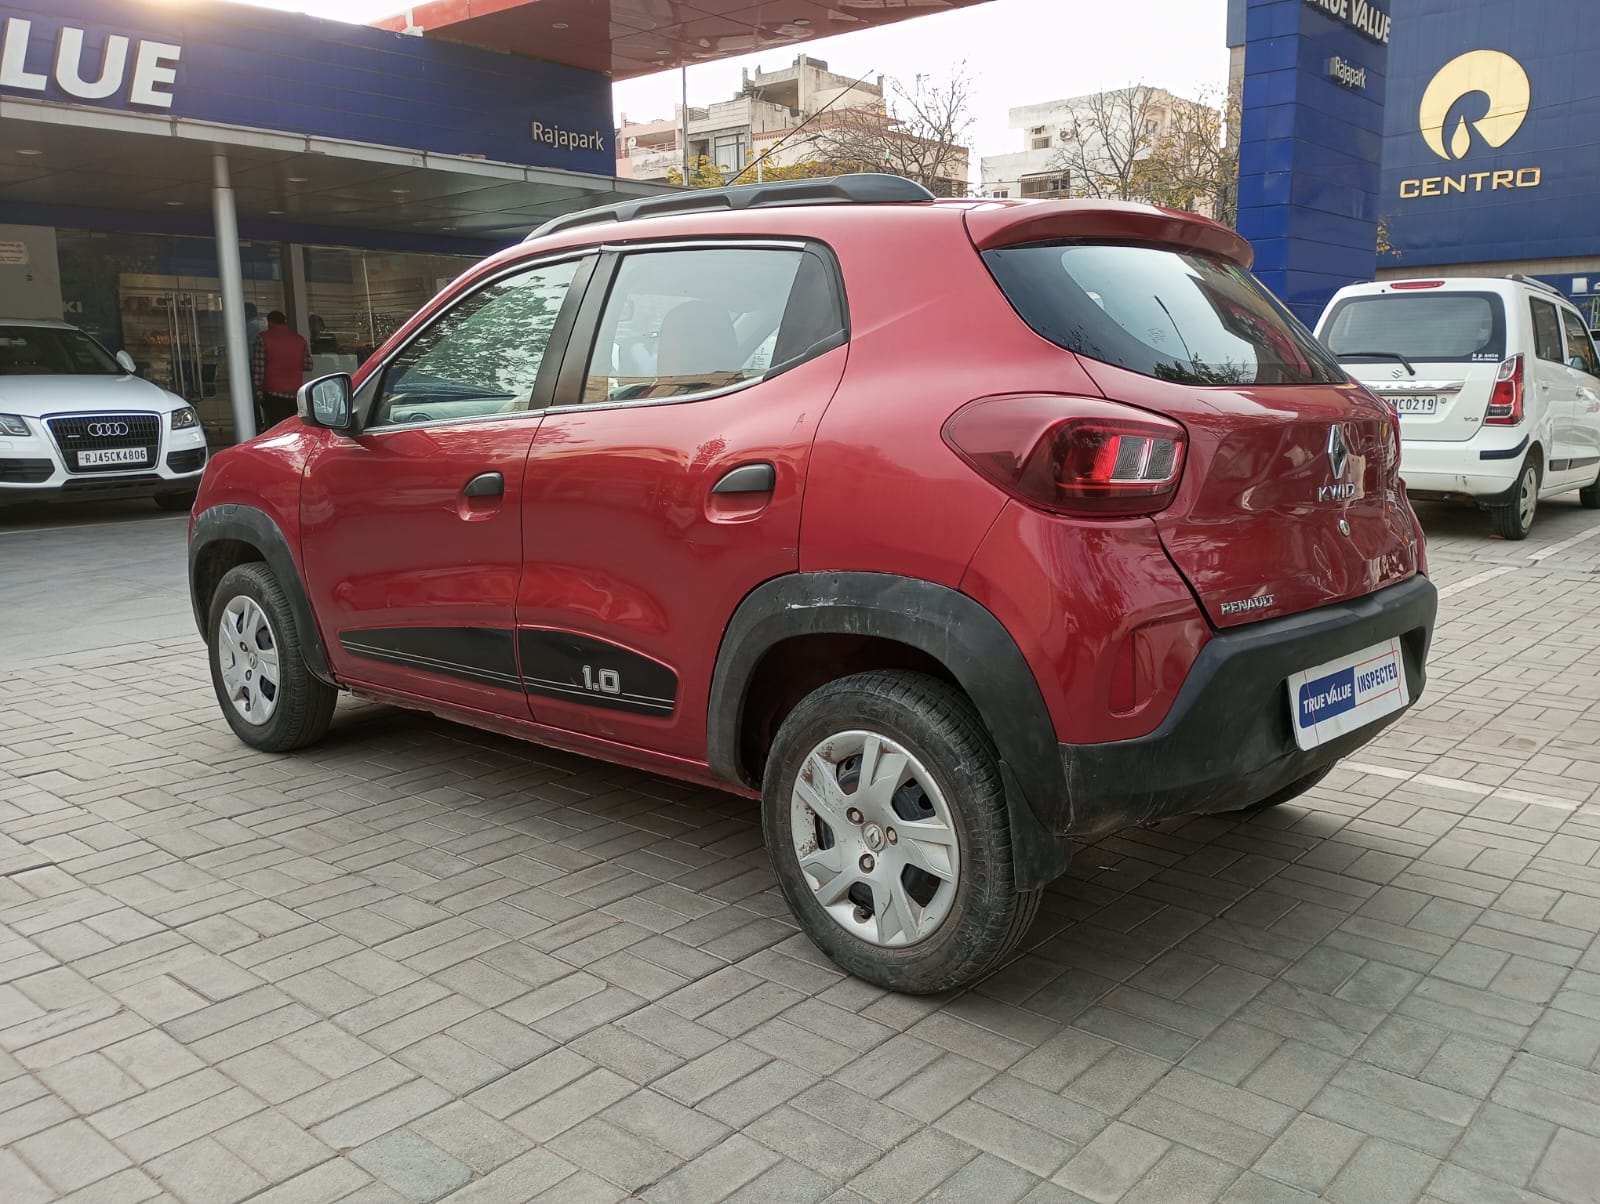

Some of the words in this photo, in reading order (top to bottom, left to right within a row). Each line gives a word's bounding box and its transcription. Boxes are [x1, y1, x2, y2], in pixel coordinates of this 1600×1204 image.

[1352, 0, 1391, 43] VALUE
[1334, 55, 1366, 88] Rajapark
[532, 121, 604, 151] Rajapark
[1399, 167, 1541, 199] CENTRO
[1387, 397, 1434, 411] NC0219
[85, 449, 146, 464] RJ45CK4806
[1318, 483, 1355, 502] KWID
[1220, 594, 1274, 615] RENAULT
[582, 664, 620, 695] 1.0
[1303, 693, 1325, 714] TRUE
[1325, 683, 1352, 705] VALUE
[1357, 662, 1398, 694] INSPECTED
